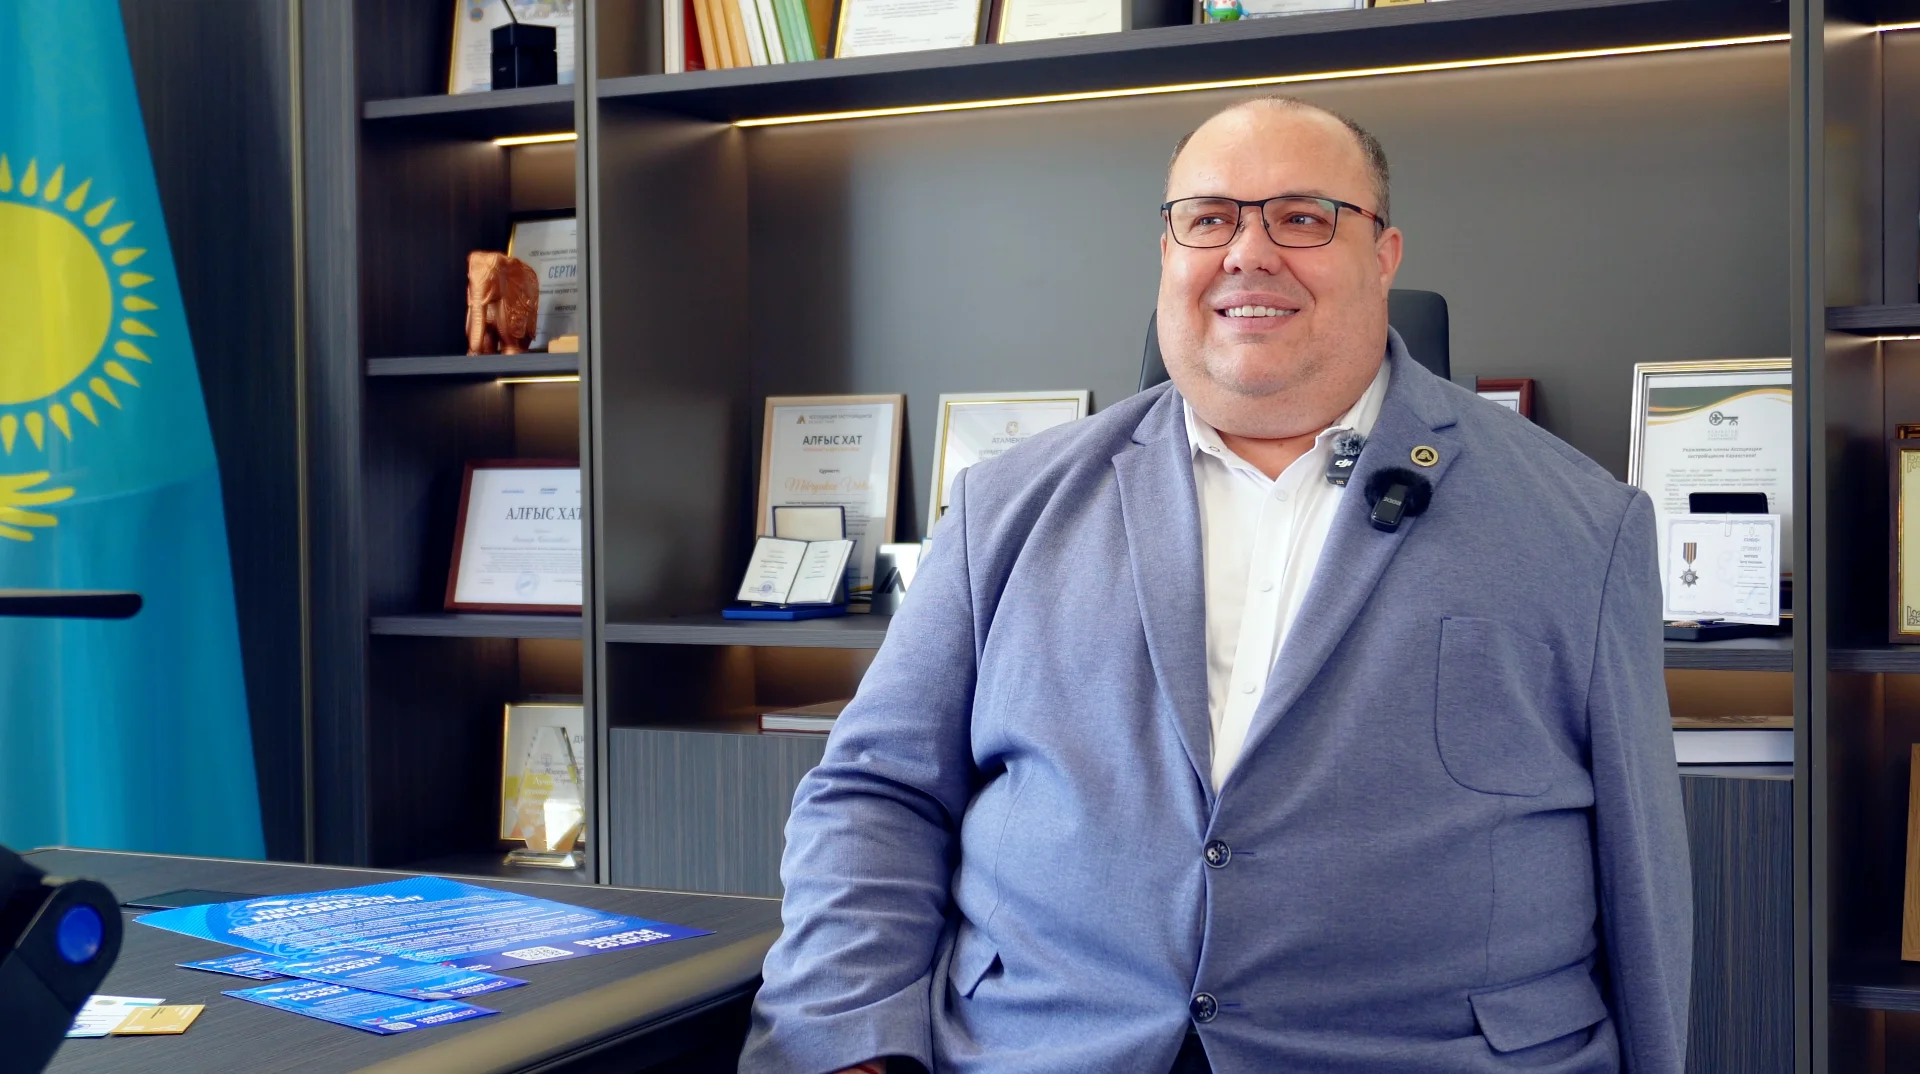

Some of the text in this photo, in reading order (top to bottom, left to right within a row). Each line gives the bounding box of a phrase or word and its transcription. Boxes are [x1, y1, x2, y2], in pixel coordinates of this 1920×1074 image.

[802, 435, 862, 446] АЛҒЫС ХАТ
[505, 507, 555, 521] АЛҒЫС
